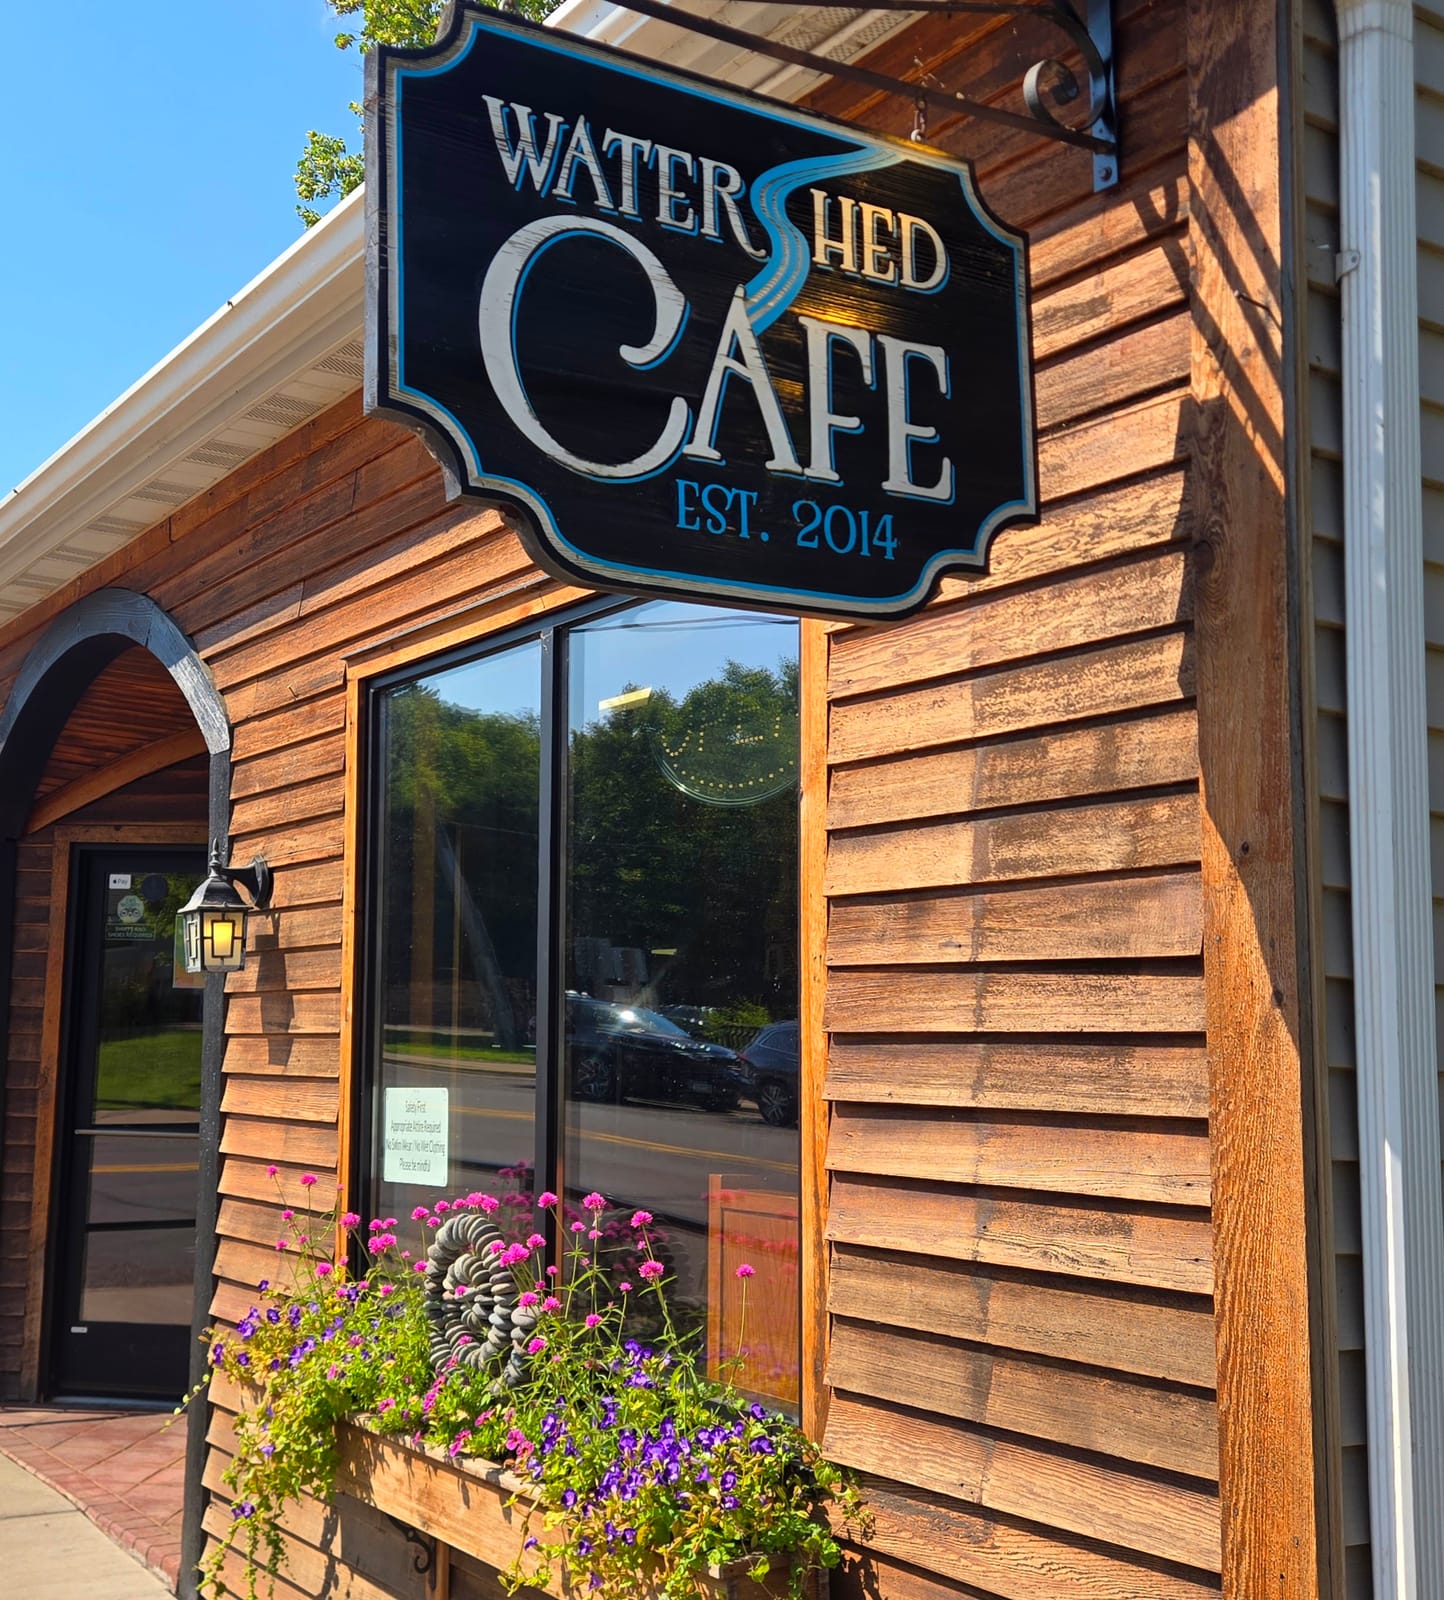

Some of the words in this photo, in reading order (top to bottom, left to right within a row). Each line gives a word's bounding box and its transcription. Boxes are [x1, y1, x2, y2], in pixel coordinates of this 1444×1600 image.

[478, 213, 955, 503] CAFE
[675, 479, 770, 542] EST.
[793, 498, 898, 561] 2014
